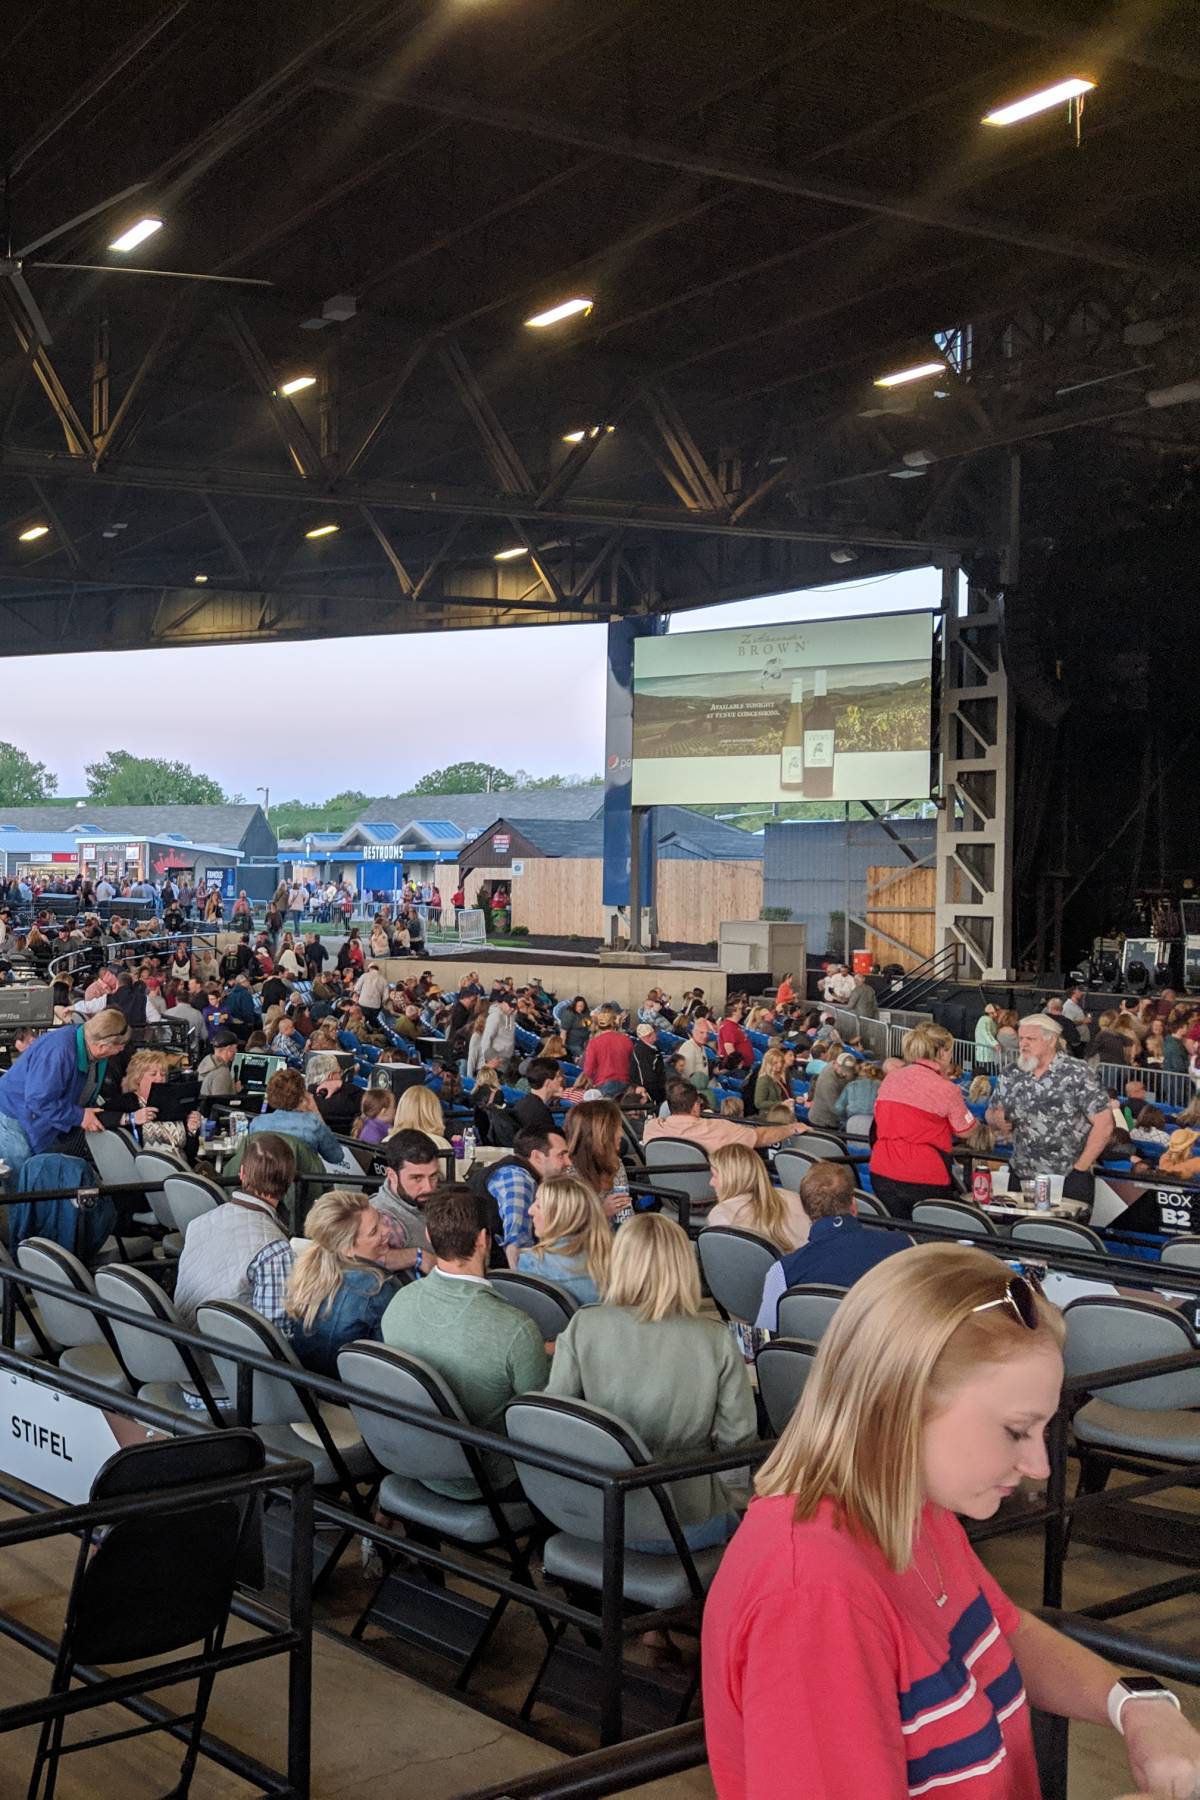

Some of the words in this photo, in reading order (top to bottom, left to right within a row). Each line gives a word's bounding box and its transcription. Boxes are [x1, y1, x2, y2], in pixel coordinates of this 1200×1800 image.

[737, 641, 806, 657] BROWN
[363, 846, 404, 860] RESTROOMS
[373, 1162, 388, 1176] BO
[1157, 1192, 1193, 1208] BOX
[1161, 1207, 1192, 1227] B2
[11, 1415, 73, 1463] STIFEL
